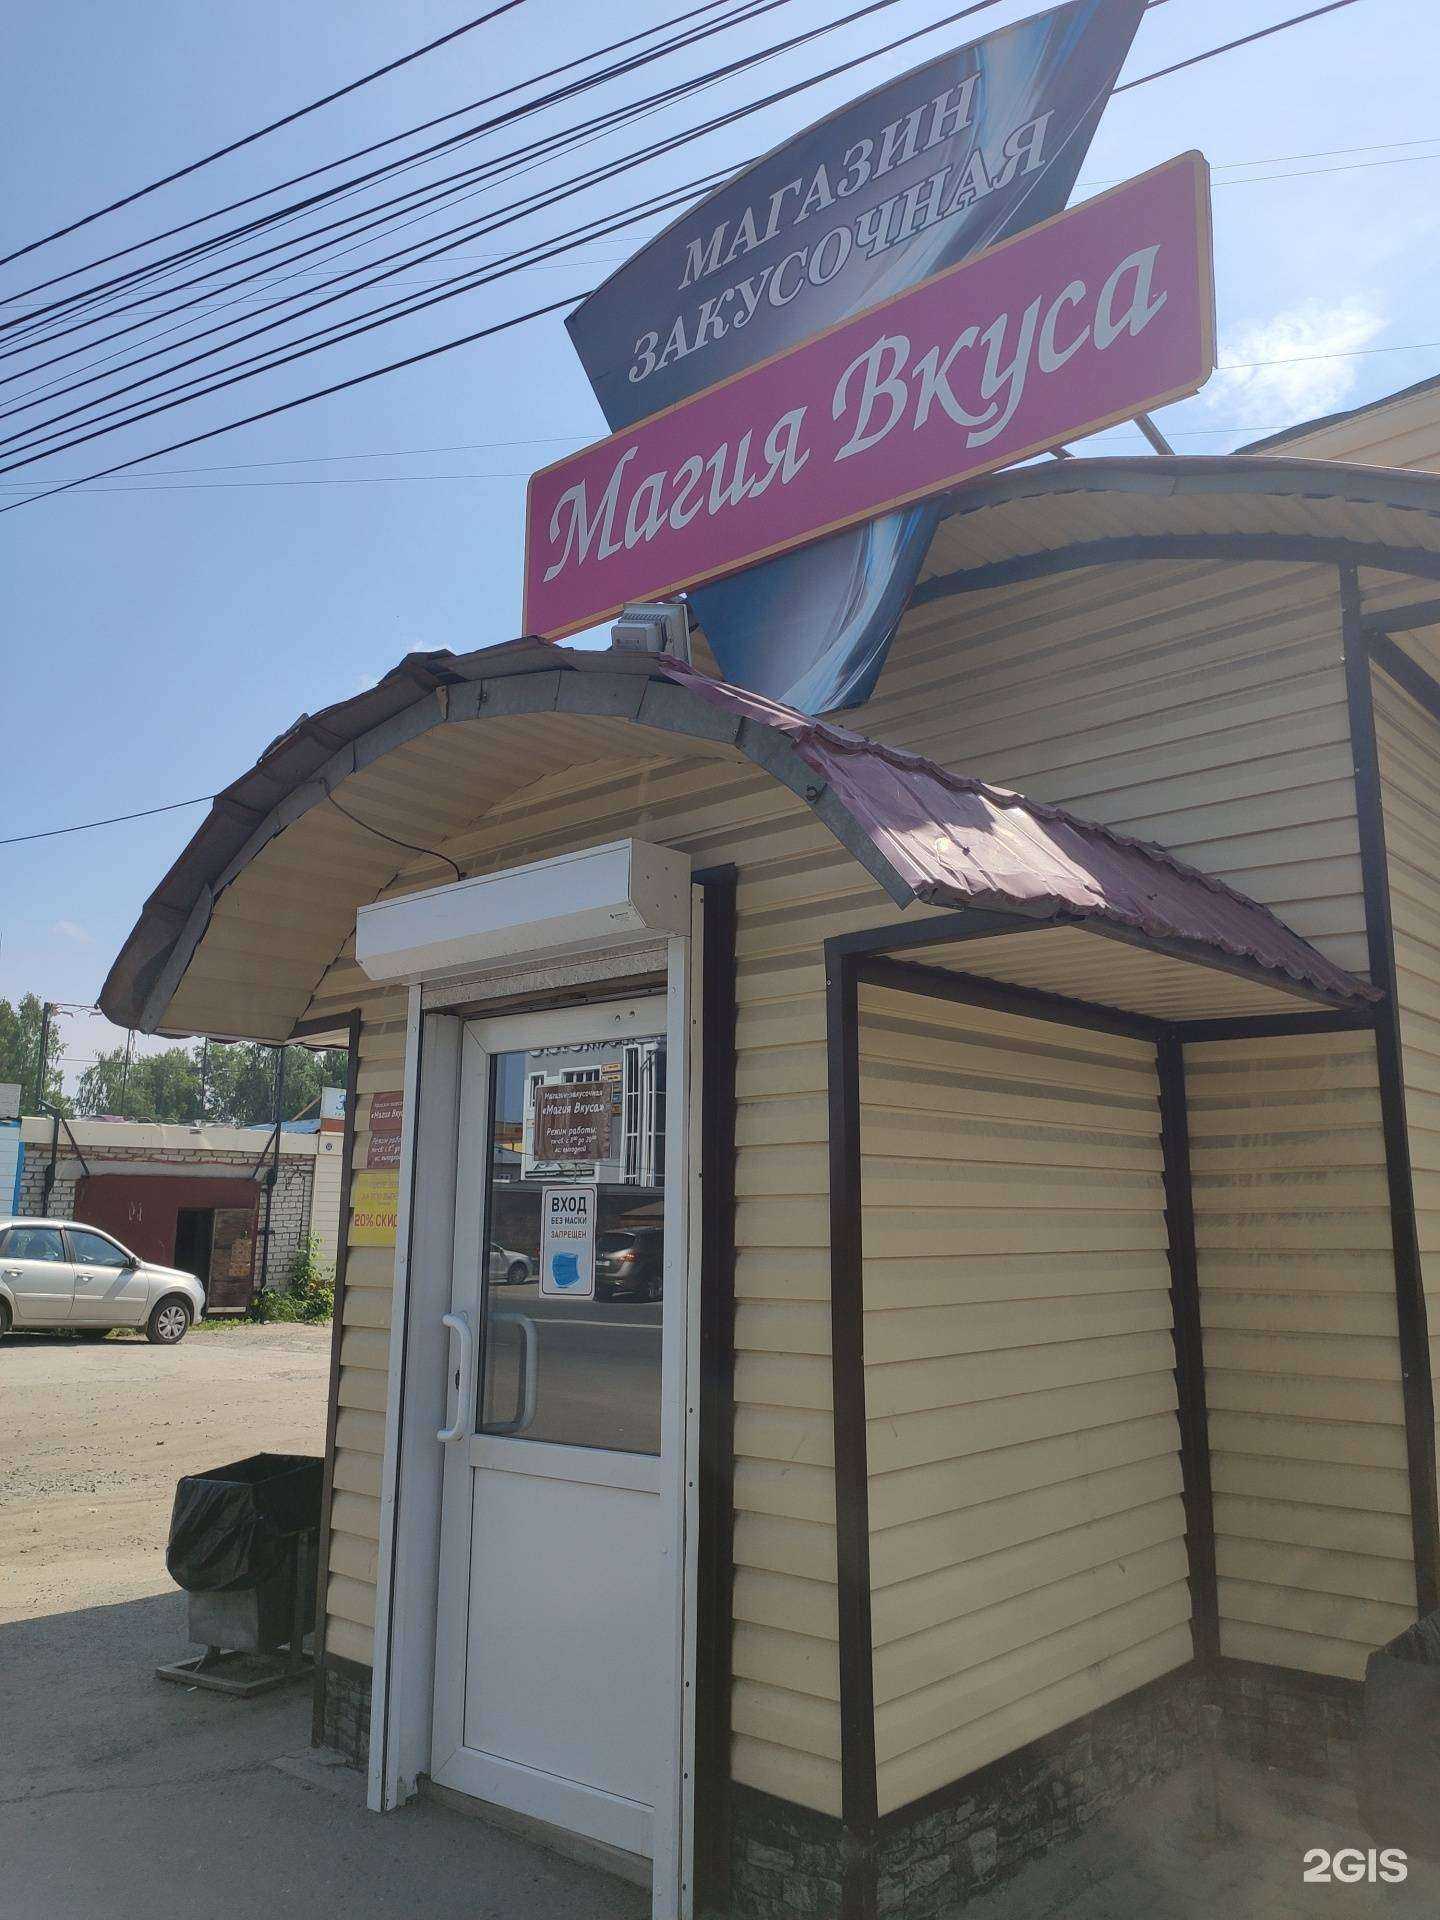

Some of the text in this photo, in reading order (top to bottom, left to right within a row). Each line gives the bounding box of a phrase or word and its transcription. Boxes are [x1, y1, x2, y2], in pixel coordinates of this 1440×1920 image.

[677, 70, 982, 291] МАГАЗИН
[627, 107, 1056, 385] ЗАКУСОЧНАЯ
[543, 243, 1168, 583] Магия Вкуса
[550, 1216, 587, 1225] БЕЗ МАСКИ
[550, 1230, 587, 1240] ЗАПРЕЩЕН
[551, 1196, 587, 1215] ВХОД
